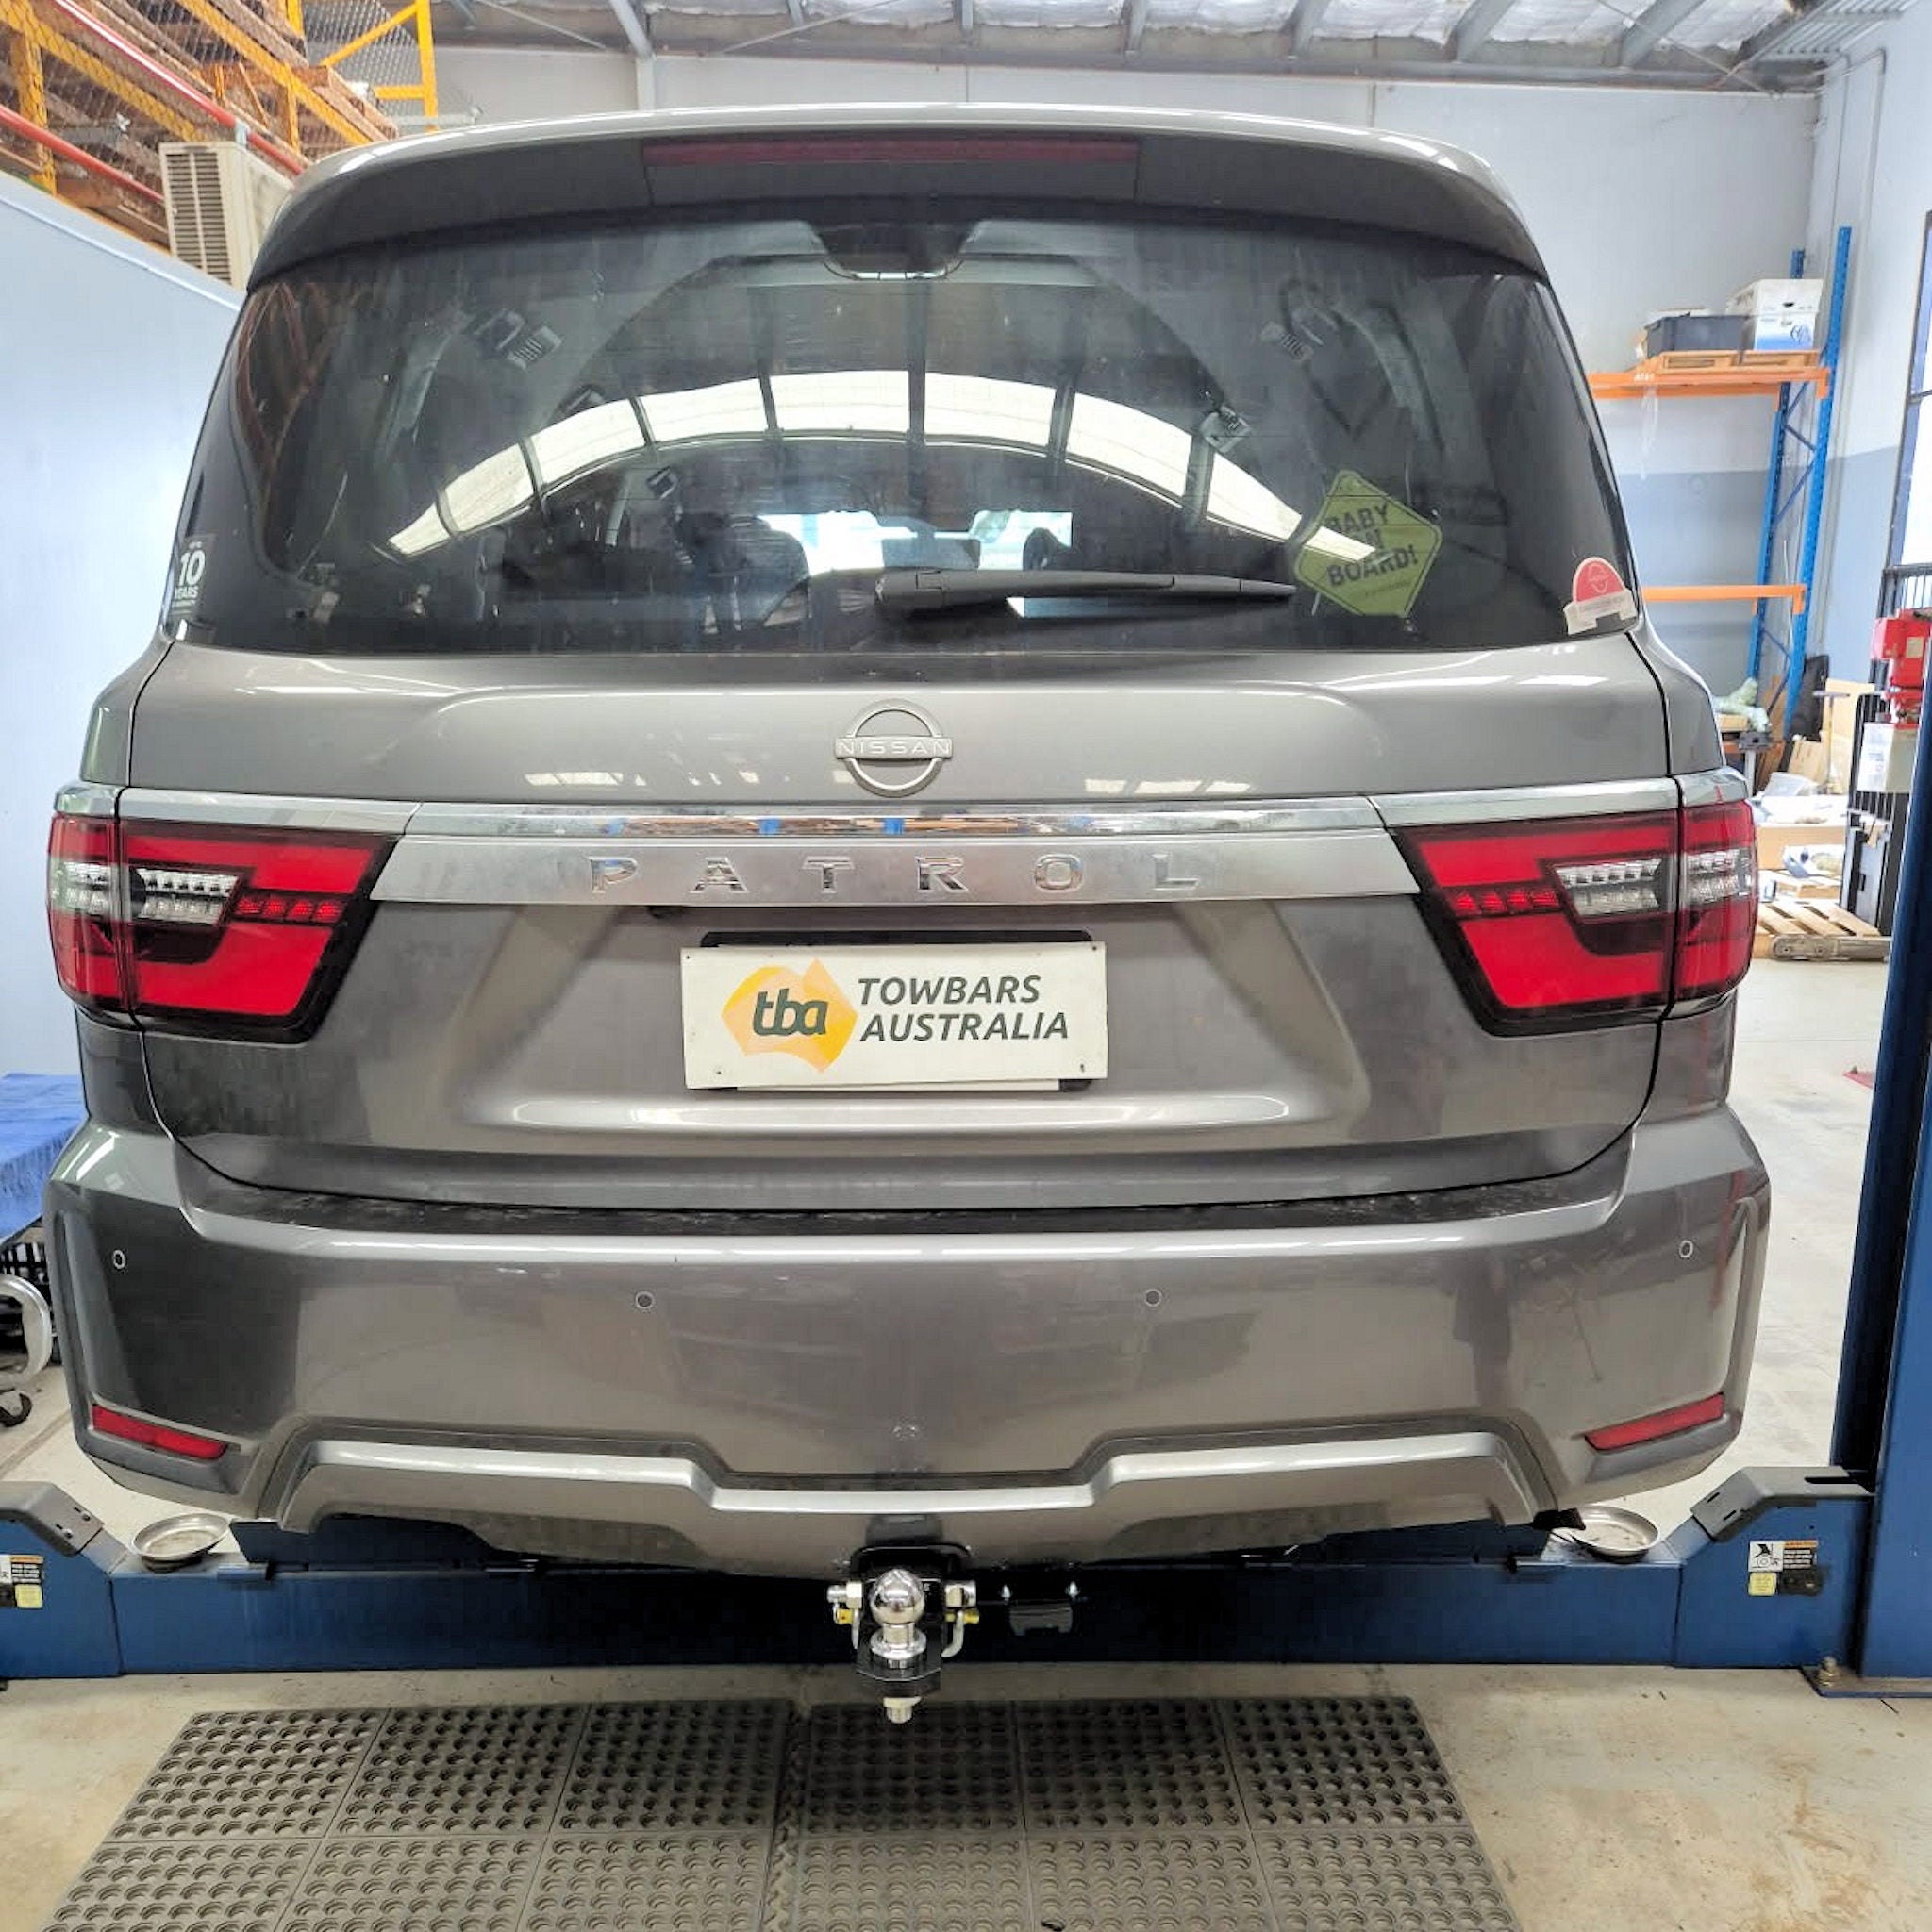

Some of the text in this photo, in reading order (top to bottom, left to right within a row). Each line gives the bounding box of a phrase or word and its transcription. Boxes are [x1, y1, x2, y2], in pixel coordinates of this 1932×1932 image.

[1324, 502, 1389, 535] BABY
[178, 550, 205, 585] 10
[1326, 544, 1418, 586] BOARD!
[837, 740, 950, 755] NISSAN
[588, 854, 1198, 894] PATROL
[858, 974, 1042, 1006] TOWBARS
[752, 988, 828, 1037] tba
[859, 1011, 1069, 1042] AUSTRALIA
